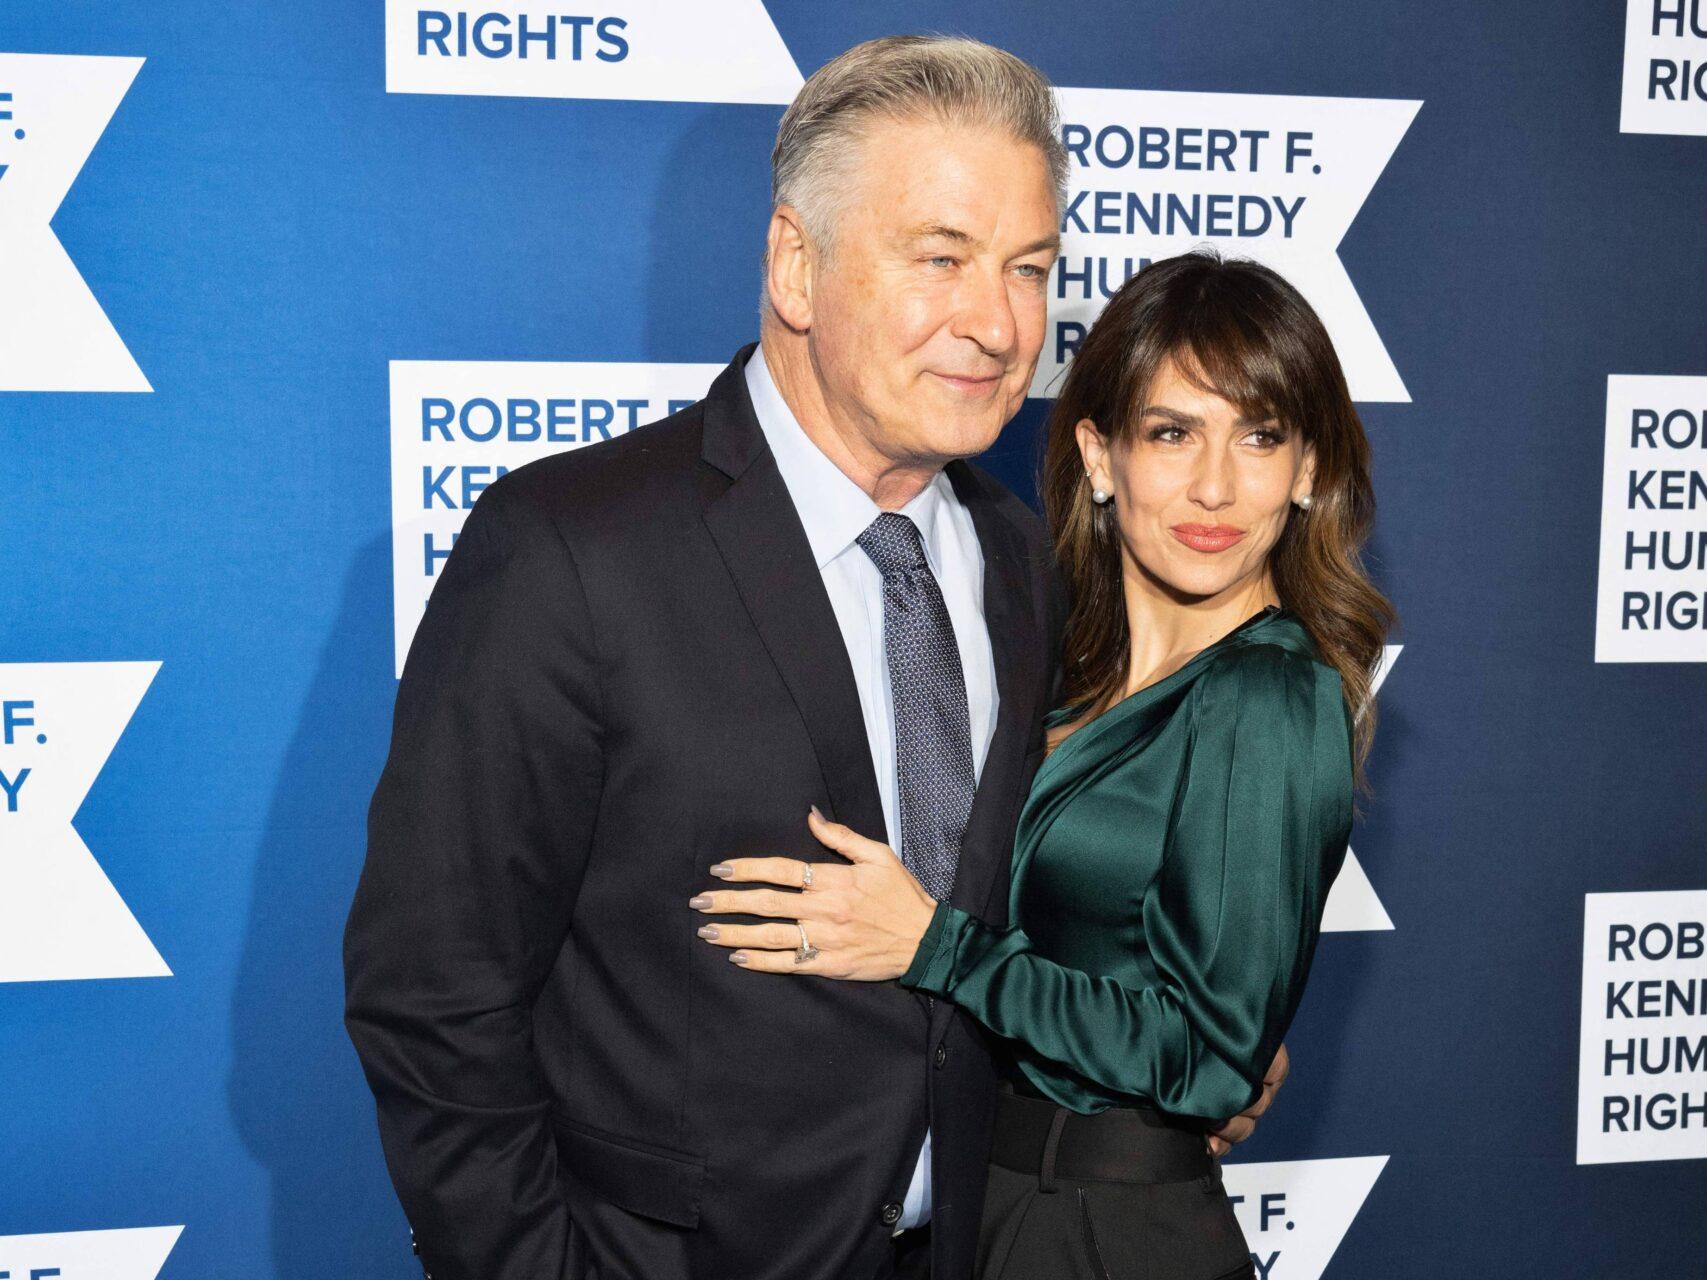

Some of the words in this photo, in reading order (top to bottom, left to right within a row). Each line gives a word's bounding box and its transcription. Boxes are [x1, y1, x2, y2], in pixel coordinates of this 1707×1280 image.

[416, 10, 630, 62] RIGHTS
[1061, 124, 1269, 172] ROBERT
[1285, 131, 1322, 174] F.
[1061, 190, 1307, 238] KENNEDY
[1057, 256, 1151, 299] HU
[421, 397, 649, 442] ROBERT
[1631, 408, 1707, 449] RO
[422, 465, 511, 509] KE
[1625, 531, 1707, 570] HU
[1622, 591, 1707, 630] RIG
[3, 700, 47, 744] F.
[1606, 978, 1707, 1019] KEN
[1260, 1193, 1295, 1232] F.
